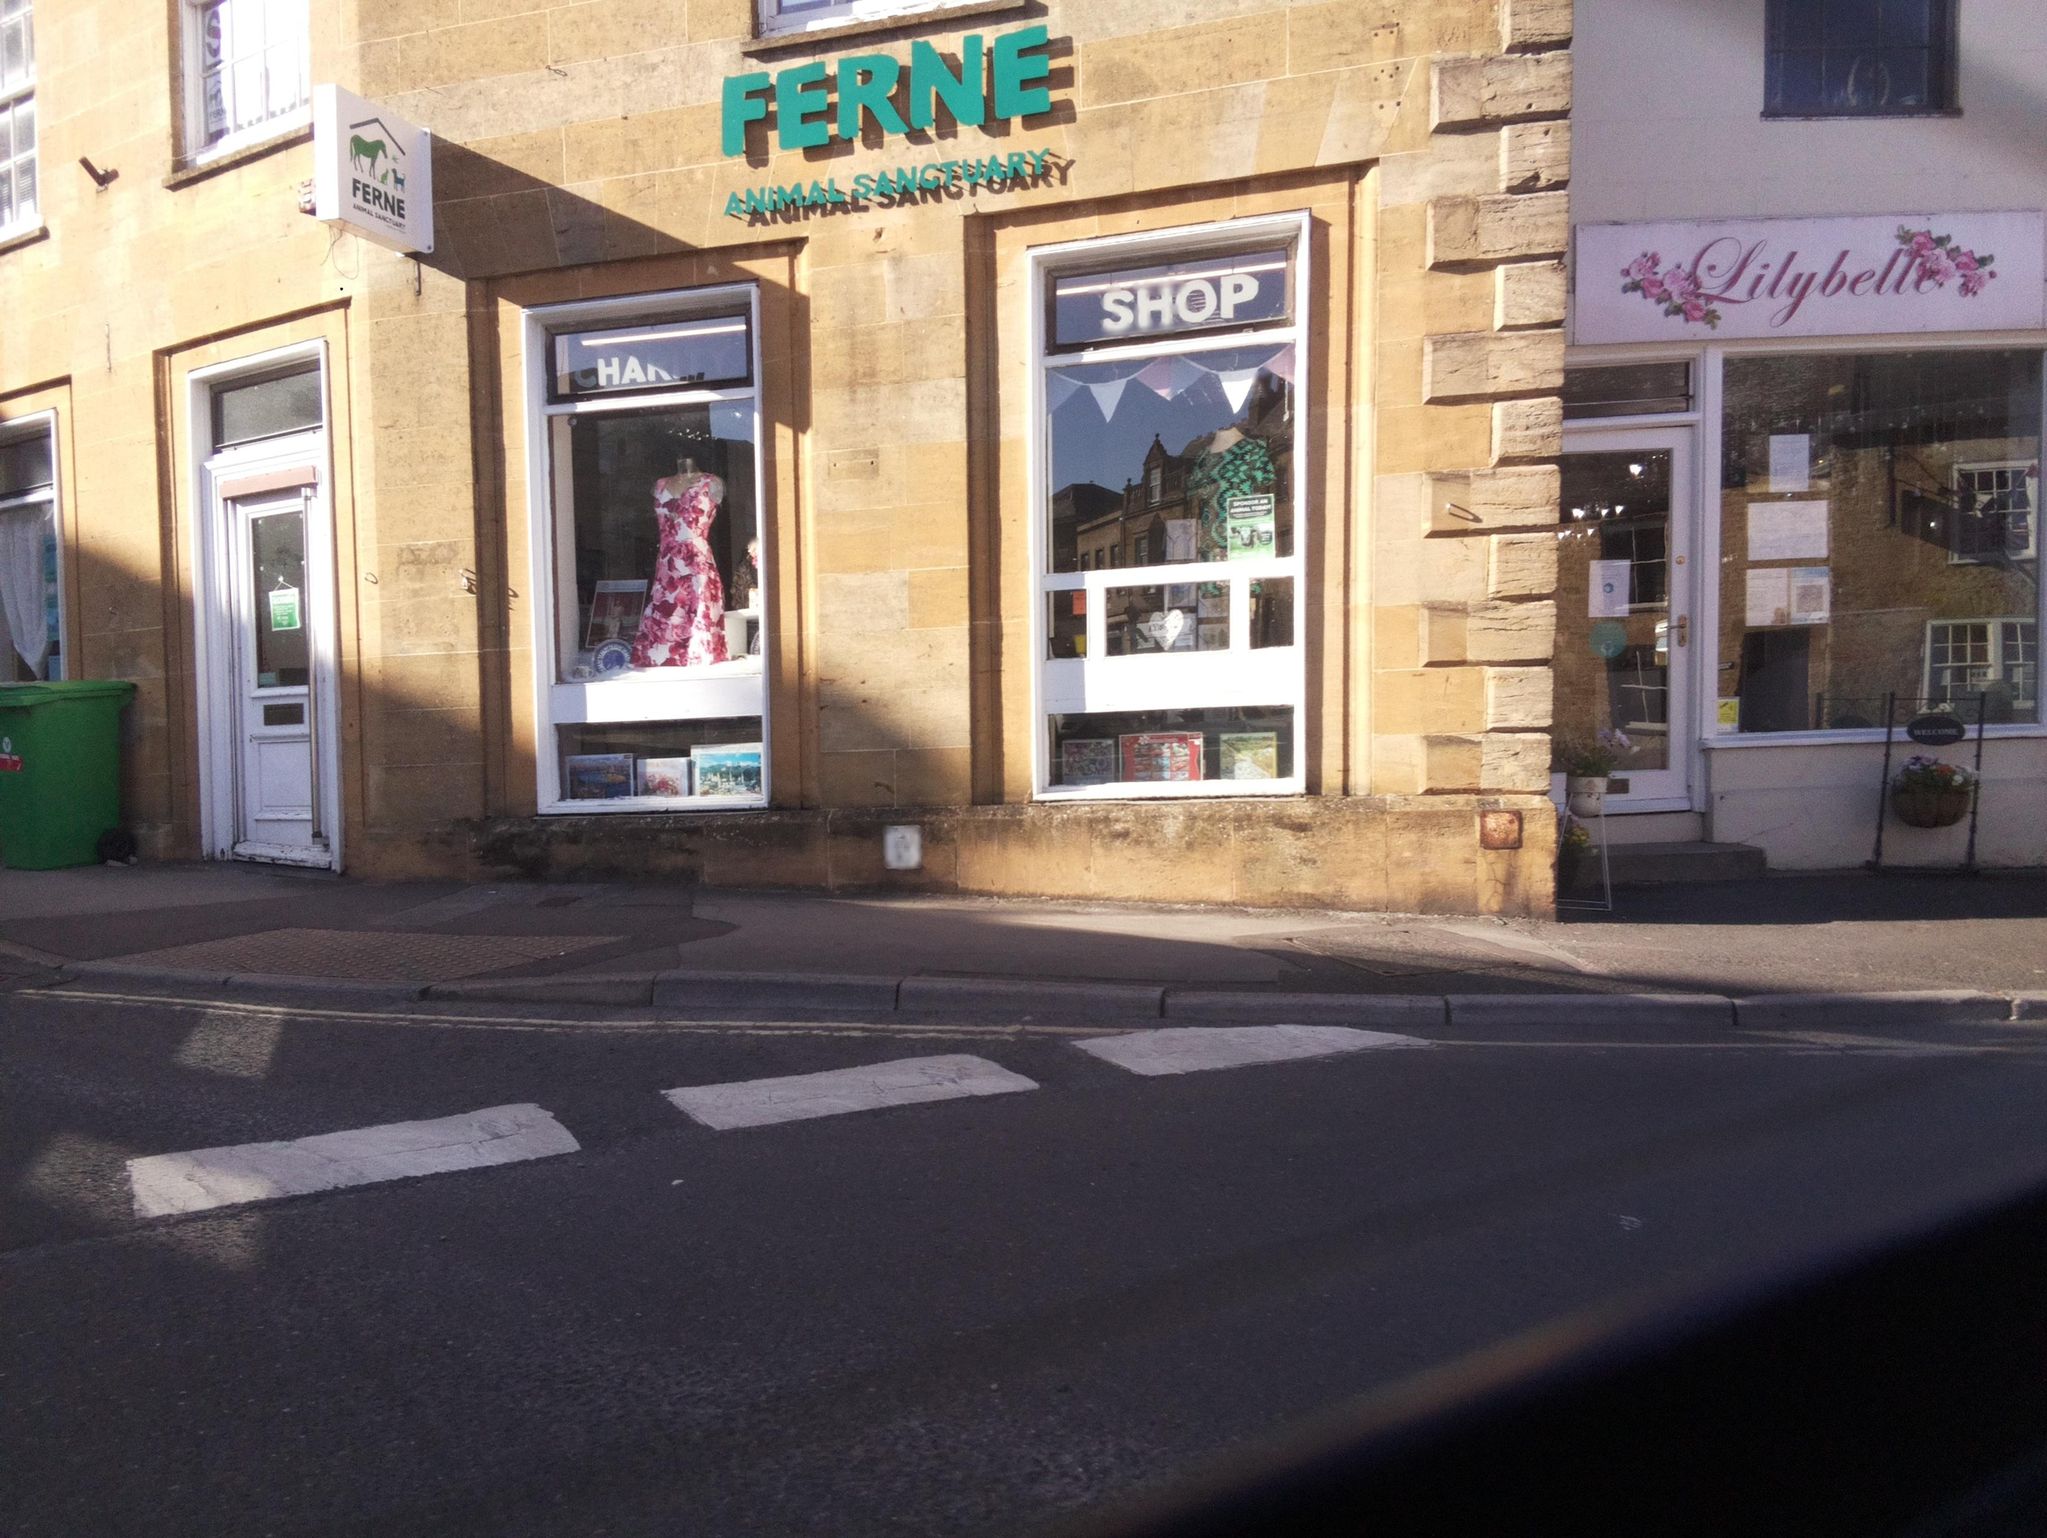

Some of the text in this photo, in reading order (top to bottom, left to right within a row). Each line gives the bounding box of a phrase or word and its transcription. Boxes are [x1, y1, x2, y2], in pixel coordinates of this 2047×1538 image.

[721, 24, 1051, 158] FERNE
[352, 178, 406, 219] FERNE
[724, 148, 1051, 216] ANIMAL SANCTUARY
[1102, 273, 1260, 333] SHOP
[1691, 236, 1939, 328] Lilybelle
[1913, 728, 1959, 736] WELCOME
